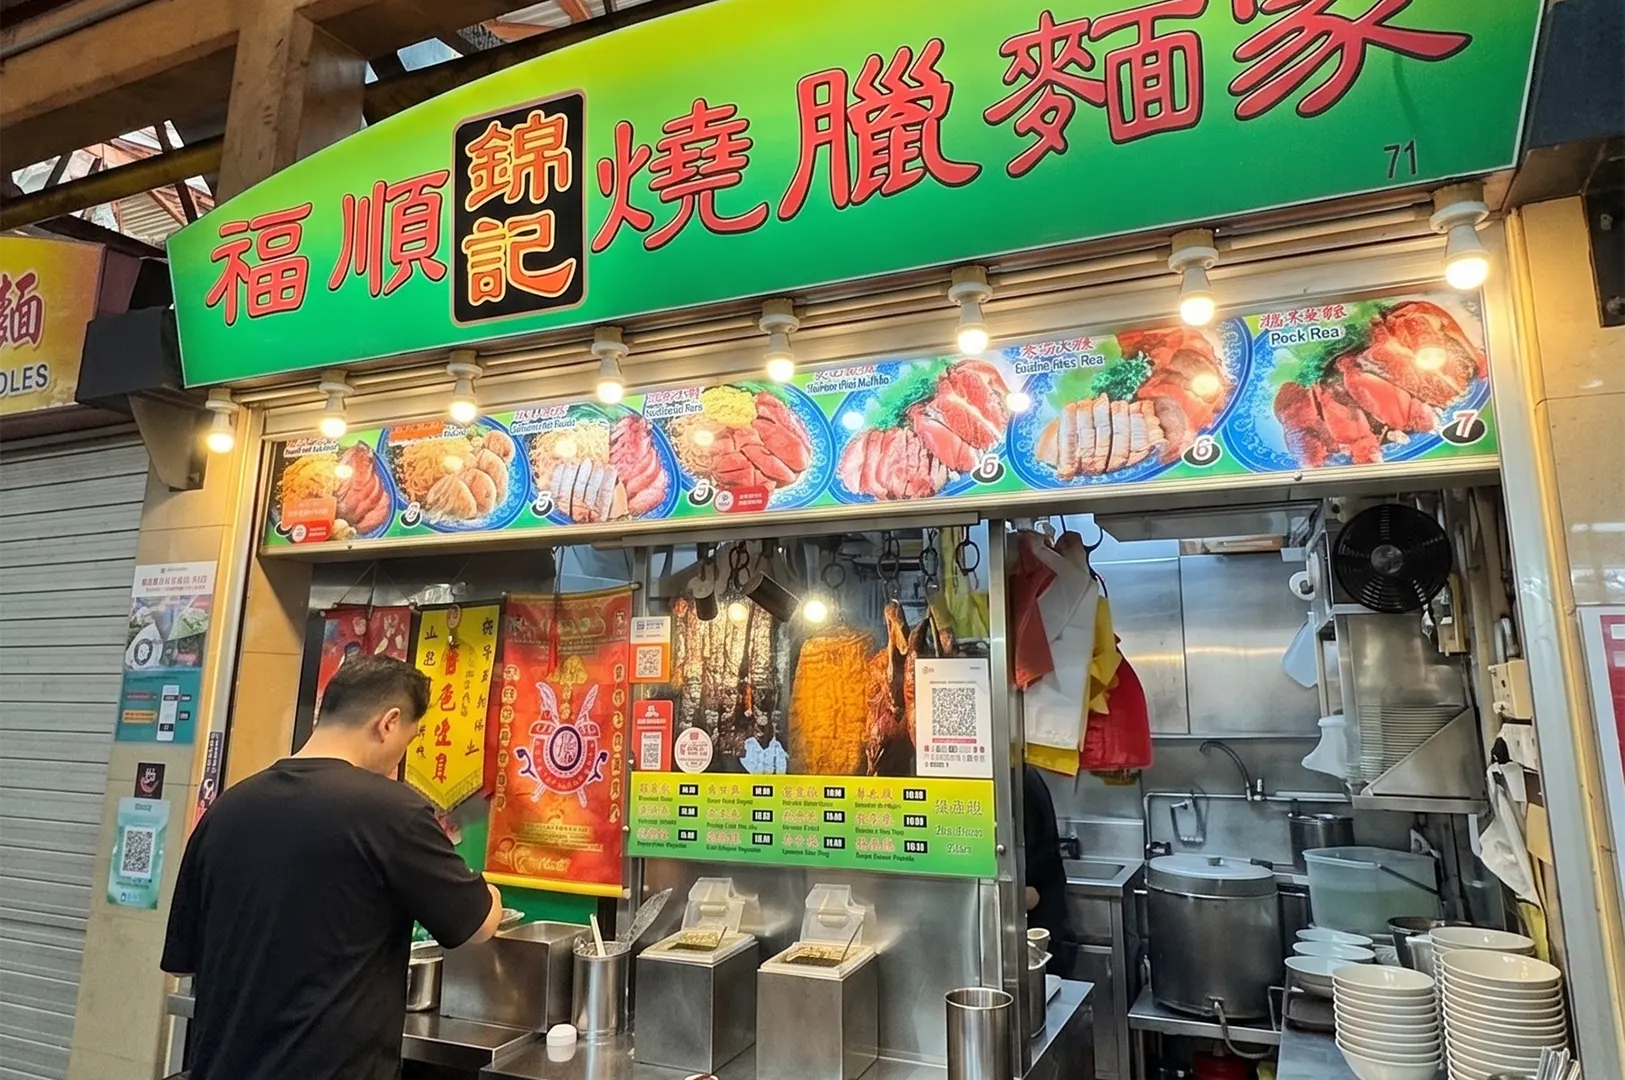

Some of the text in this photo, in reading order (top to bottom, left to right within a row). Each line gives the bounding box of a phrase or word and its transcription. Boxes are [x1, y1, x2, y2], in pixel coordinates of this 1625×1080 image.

[1383, 139, 1417, 178] 71
[462, 109, 577, 306] 錦記
[204, 169, 451, 326] 福順
[1271, 329, 1306, 345] Pock
[1455, 410, 1478, 439] 7
[1194, 436, 1213, 460] 6
[981, 453, 998, 476] 6
